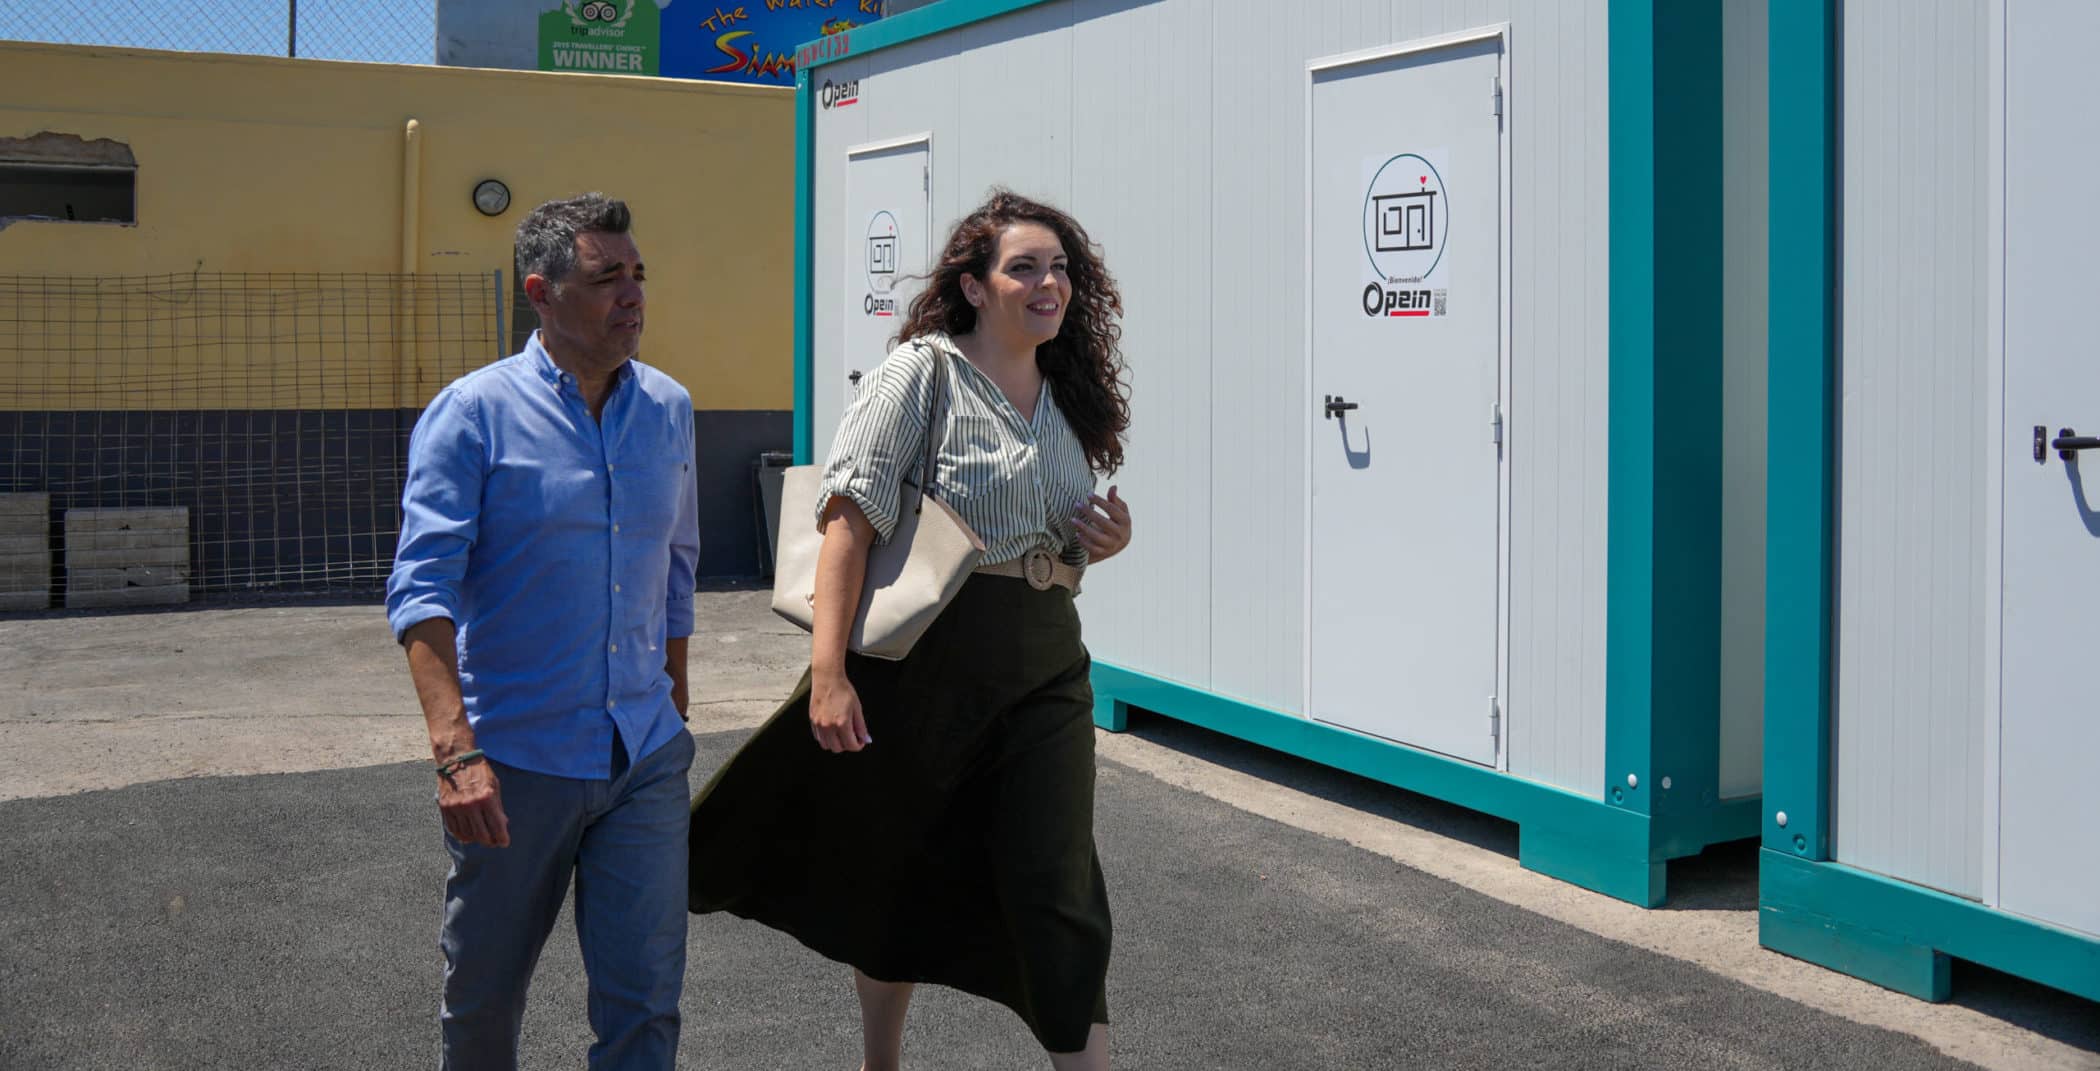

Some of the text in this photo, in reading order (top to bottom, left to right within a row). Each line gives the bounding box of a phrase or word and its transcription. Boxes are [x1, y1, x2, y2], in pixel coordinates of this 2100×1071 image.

[700, 7, 749, 31] The
[571, 26, 625, 37] tripadvisor
[553, 49, 643, 71] WINNER
[822, 79, 859, 110] Opein
[864, 293, 893, 315] Opein
[1363, 281, 1432, 317] Opein
